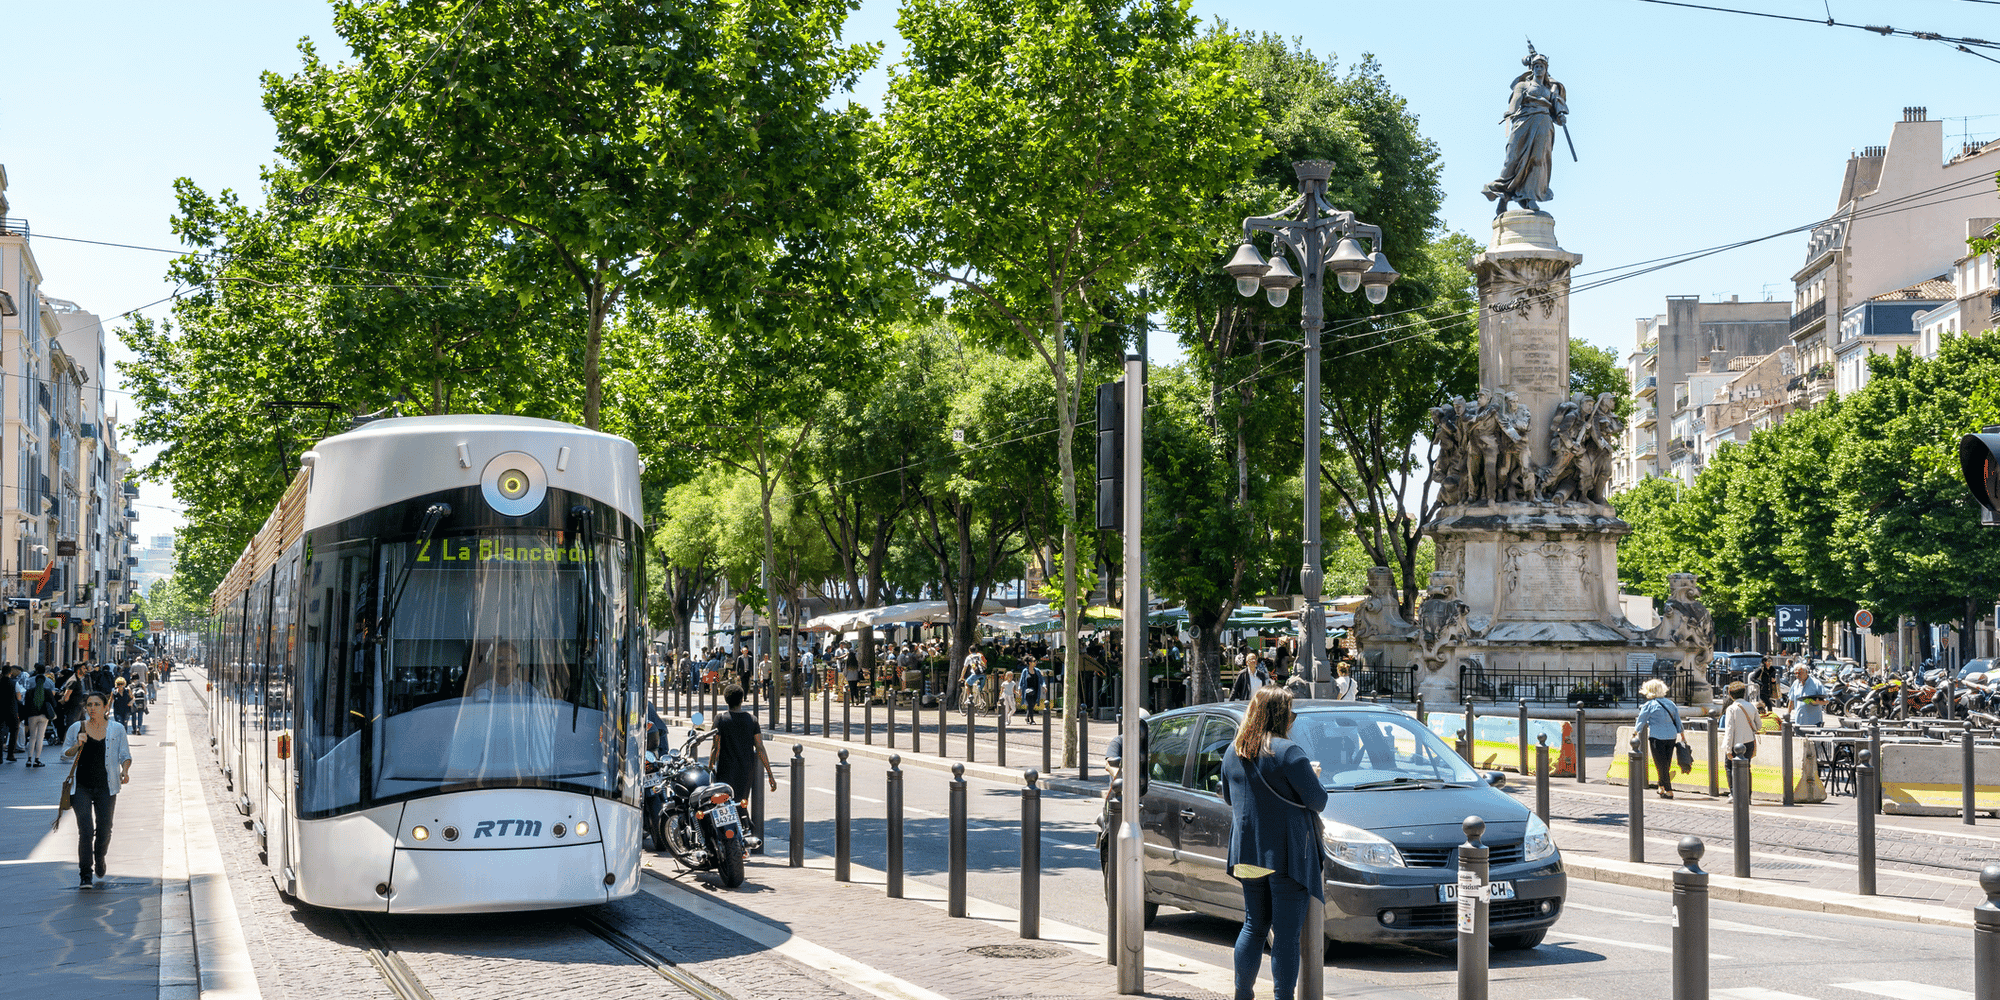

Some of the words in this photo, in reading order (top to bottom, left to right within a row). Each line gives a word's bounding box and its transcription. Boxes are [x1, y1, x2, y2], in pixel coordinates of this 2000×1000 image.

[416, 539, 431, 562] 2
[443, 539, 470, 561] La
[479, 539, 594, 563] Blancarde
[1779, 610, 1791, 627] P
[719, 808, 728, 816] BJ
[474, 819, 542, 839] RTM
